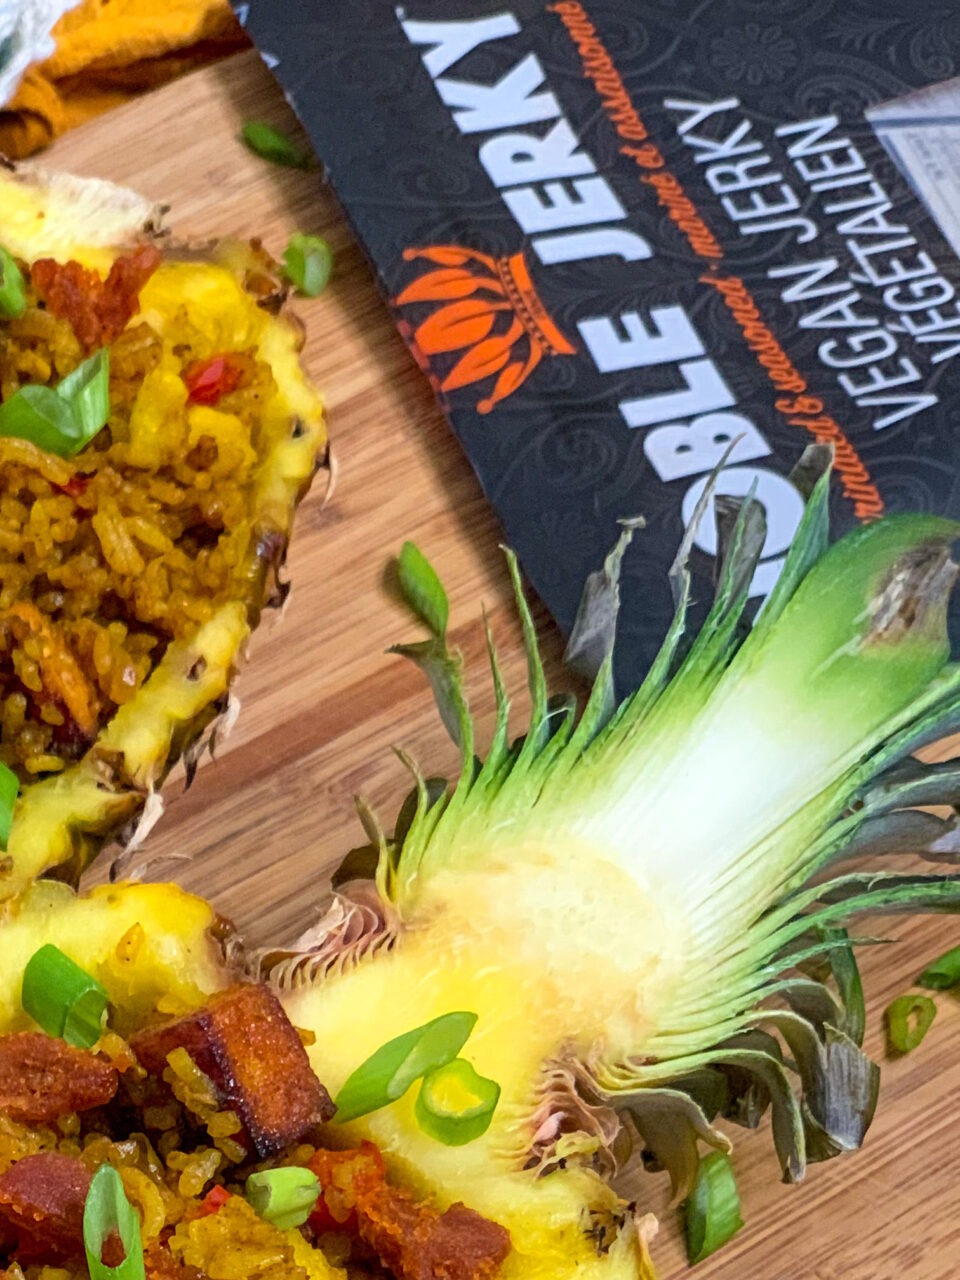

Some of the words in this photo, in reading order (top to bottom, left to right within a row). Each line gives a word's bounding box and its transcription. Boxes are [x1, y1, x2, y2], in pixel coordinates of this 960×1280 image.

[403, 12, 653, 266] JERKY
[618, 142, 665, 169] et
[663, 97, 818, 244] JERKY
[774, 114, 960, 364] VÉGÉTALIEN
[698, 276, 807, 393] seasoned
[766, 258, 939, 431] VEGAN
[577, 304, 806, 626] OBLE
